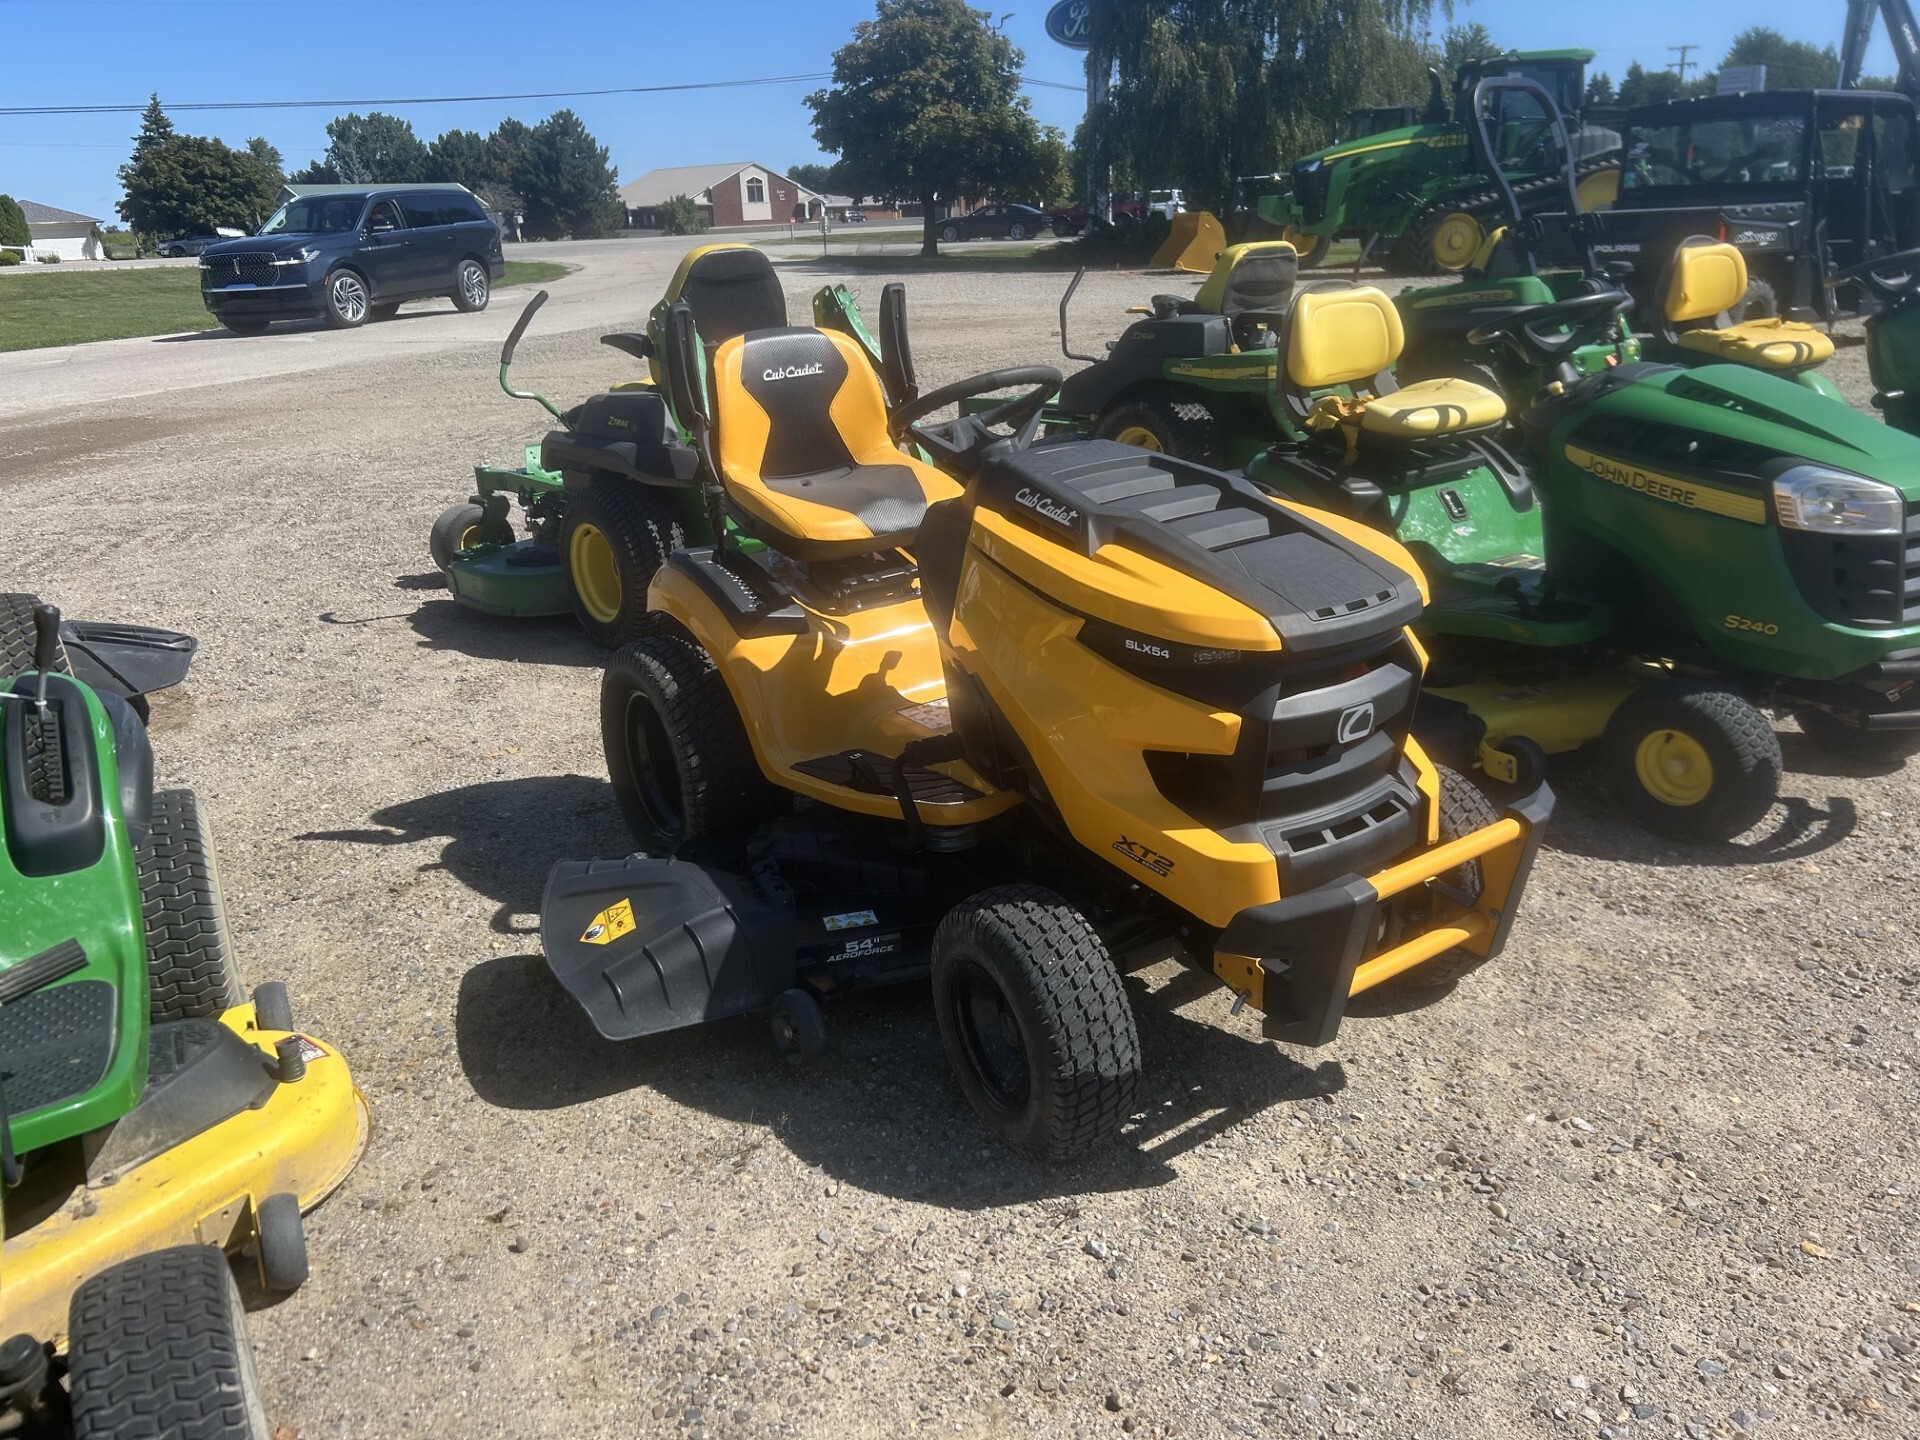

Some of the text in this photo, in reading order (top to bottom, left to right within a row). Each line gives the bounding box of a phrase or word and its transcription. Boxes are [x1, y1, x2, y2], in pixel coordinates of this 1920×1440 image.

[1593, 244, 1641, 253] POLARIS
[763, 363, 823, 381] Cub Cadet
[607, 416, 630, 428] ZTRAK
[1584, 456, 1697, 506] JOHN DEERE
[1014, 487, 1079, 527] Cub Cadet
[1724, 614, 1779, 635] S240
[1125, 639, 1170, 659] SLX54
[1113, 833, 1175, 872] XT2
[826, 944, 894, 962] AEROFORCE
[845, 937, 880, 953] 54"
